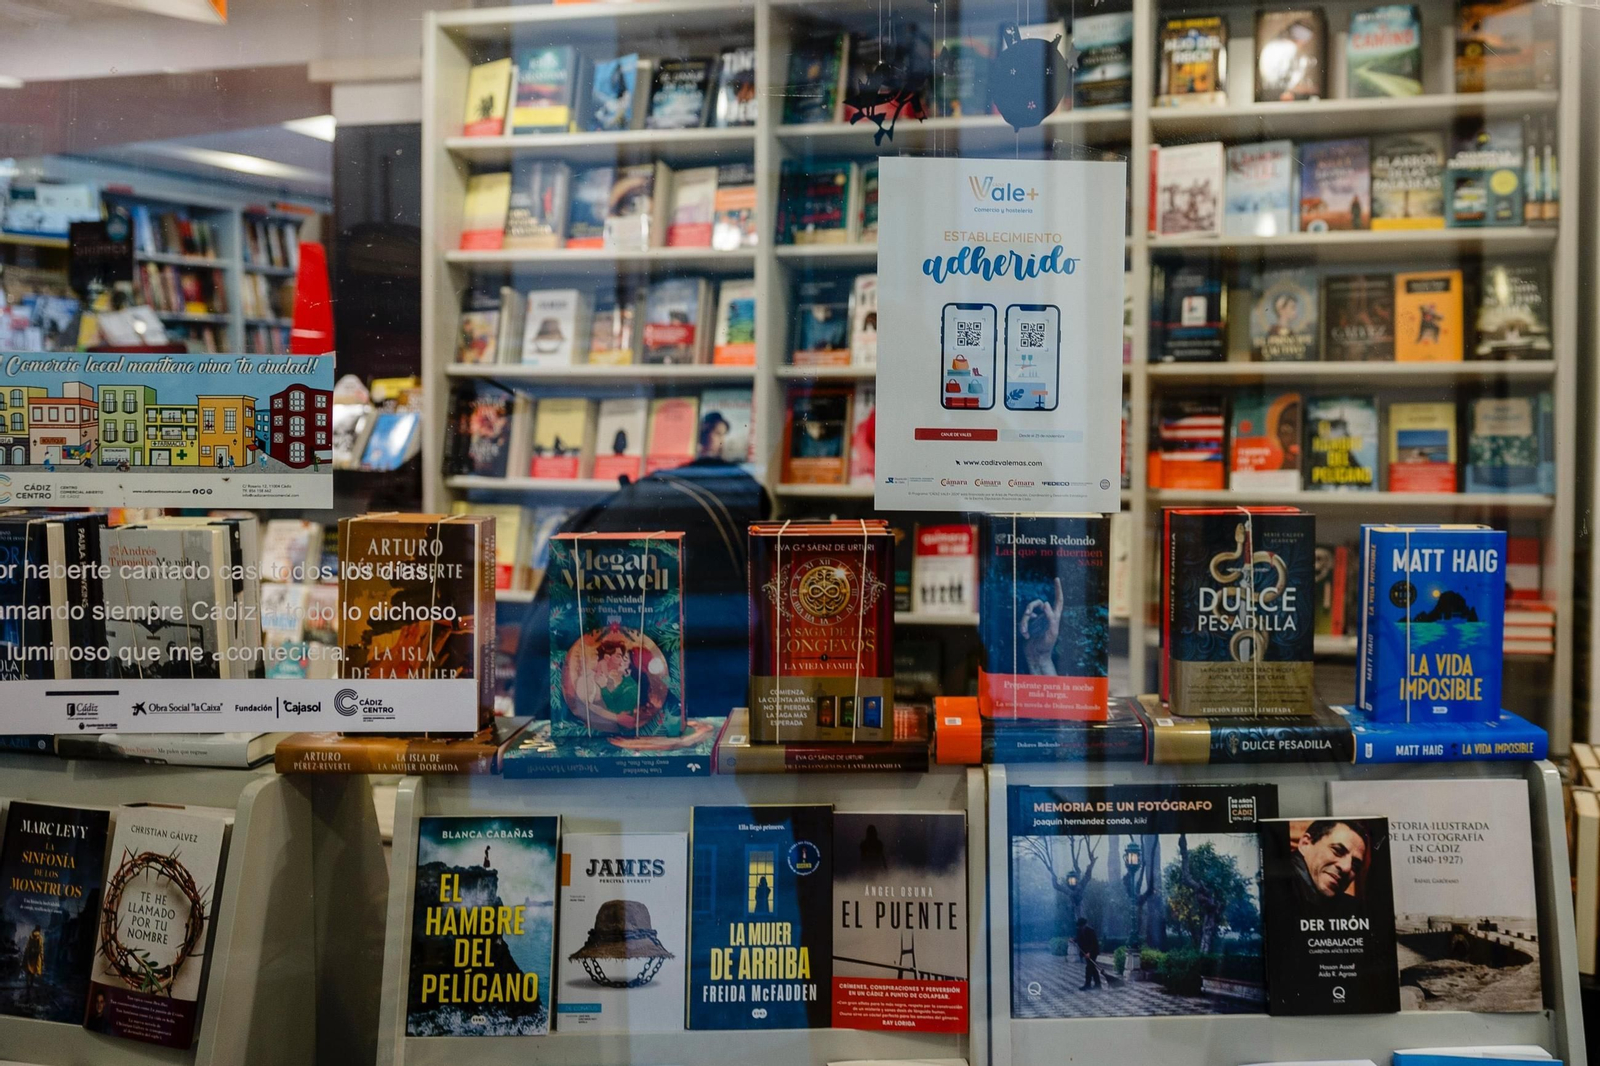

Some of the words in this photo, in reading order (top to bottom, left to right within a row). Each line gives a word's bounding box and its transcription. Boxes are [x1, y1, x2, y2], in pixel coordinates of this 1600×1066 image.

[944, 231, 1062, 243] ESTABLECIMIENTO
[923, 245, 1081, 283] adherido
[6, 355, 80, 377] Comercio
[86, 356, 125, 374] local
[129, 356, 194, 374] mantiene
[199, 360, 233, 374] viva
[235, 357, 255, 374] tu
[257, 357, 319, 375] ciudad!
[24, 482, 50, 491] CÁDIZ
[941, 478, 968, 487] Cámara
[975, 478, 1001, 487] Cámara
[1008, 479, 1035, 488] Cámara
[1007, 534, 1047, 545] Dolores
[1050, 535, 1095, 546] Redondo
[121, 547, 157, 556] Andrés
[368, 538, 443, 556] ARTURO
[848, 543, 874, 551] URTURI
[1018, 548, 1037, 558] que
[1040, 548, 1053, 556] no
[1057, 547, 1102, 557] duermen
[569, 549, 657, 573] Megan
[1393, 549, 1445, 572] MATT
[1453, 549, 1498, 573] HAIG
[25, 560, 112, 579] haberte
[119, 561, 211, 579] cantado
[219, 561, 263, 579] casi
[270, 561, 333, 579] todos
[341, 561, 373, 580] los
[380, 561, 434, 583] días,
[562, 569, 668, 590] Maxwell
[606, 595, 643, 603] Navidad
[1199, 587, 1296, 612] DULCE
[92, 601, 183, 625] siempre
[192, 600, 256, 620] Cádiz
[343, 601, 362, 621] lo
[1198, 615, 1296, 631] PESADILLA
[795, 627, 826, 637] SAGA
[775, 639, 875, 652] LONGEVOS
[7, 641, 110, 661] luminoso
[118, 646, 161, 666] que
[169, 646, 204, 661] me
[374, 646, 392, 661] LA
[402, 647, 436, 662] ISLA
[785, 662, 797, 670] LA
[799, 662, 824, 670] VIEJA
[1411, 654, 1429, 676] LA
[1436, 654, 1473, 676] VIDA
[1028, 690, 1045, 698] más
[1043, 683, 1061, 692] para
[1072, 683, 1094, 692] noche
[1400, 678, 1482, 701] IMPOSIBLE
[76, 703, 99, 712] Cádiz
[149, 703, 167, 712] Obra
[169, 703, 189, 712] Social
[235, 703, 272, 713] Fundación
[283, 700, 321, 715] Cajasol
[359, 698, 382, 706] CÁDIZ
[1242, 741, 1276, 750] DULCE
[1279, 740, 1332, 750] PESADILLA
[1396, 745, 1420, 756] MATT
[1423, 745, 1443, 756] HAIG
[1462, 743, 1472, 755] LA
[1474, 743, 1492, 754] VIDA
[1495, 742, 1534, 754] IMPOSIBLE
[304, 752, 341, 761] ARTURO
[396, 753, 406, 762] LA
[409, 753, 427, 762] ISLA
[430, 753, 440, 762] DE
[294, 761, 351, 771] PÉREZ-REVERTE
[378, 762, 388, 771] LA
[391, 762, 416, 772] MUJER
[419, 763, 459, 772] DORMIDA
[1033, 802, 1094, 813] MEMORIA
[1097, 802, 1114, 812] DE
[1116, 801, 1134, 812] UN
[1138, 799, 1213, 812] FOTÓGRAFO
[763, 824, 785, 832] primero.
[1033, 817, 1063, 827] joaquín
[1064, 816, 1105, 826] hernández
[1106, 817, 1132, 826] conde,
[1432, 822, 1489, 830] ILUSTRADA
[20, 819, 55, 835] MARC
[56, 823, 89, 839] LEVY
[131, 825, 168, 838] CHRISTIAN
[170, 829, 198, 843] GÁLVEZ
[442, 830, 483, 839] BLANCA
[486, 828, 534, 839] CABAÑAS
[1402, 833, 1414, 842] LA
[1416, 831, 1484, 842] FOTOGRAFÍA
[1410, 844, 1424, 852] EN
[1427, 842, 1460, 853] CÁDIZ
[22, 850, 75, 869] SINFONÍA
[1407, 855, 1463, 865] (1840-1927)
[586, 858, 666, 878] JAMES
[10, 877, 82, 898] MONSTRUOS
[439, 873, 462, 903] EL
[865, 884, 895, 897] ÁNGEL
[901, 886, 933, 898] OSUNA
[141, 891, 151, 903] TE
[155, 893, 167, 906] HE
[128, 901, 175, 920] LLAMADO
[842, 901, 863, 928] EL
[876, 901, 957, 931] PUENTE
[131, 917, 151, 929] POR
[155, 920, 167, 932] TU
[425, 905, 527, 936] HAMBRE
[1300, 919, 1324, 931] DER
[1329, 915, 1370, 931] TIRÓN
[127, 928, 168, 945] NOMBRE
[730, 922, 744, 946] LA
[749, 922, 791, 946] MUJER
[1308, 937, 1364, 947] CAMBALACHE
[454, 938, 495, 968] DEL
[710, 947, 733, 981] DE
[738, 946, 811, 980] ARRIBA
[421, 969, 538, 1004] PELÍCANO
[869, 984, 919, 992] CONSPIRACIONES
[703, 985, 746, 1003] FREIDA
[751, 984, 817, 1001] McFADDEN
